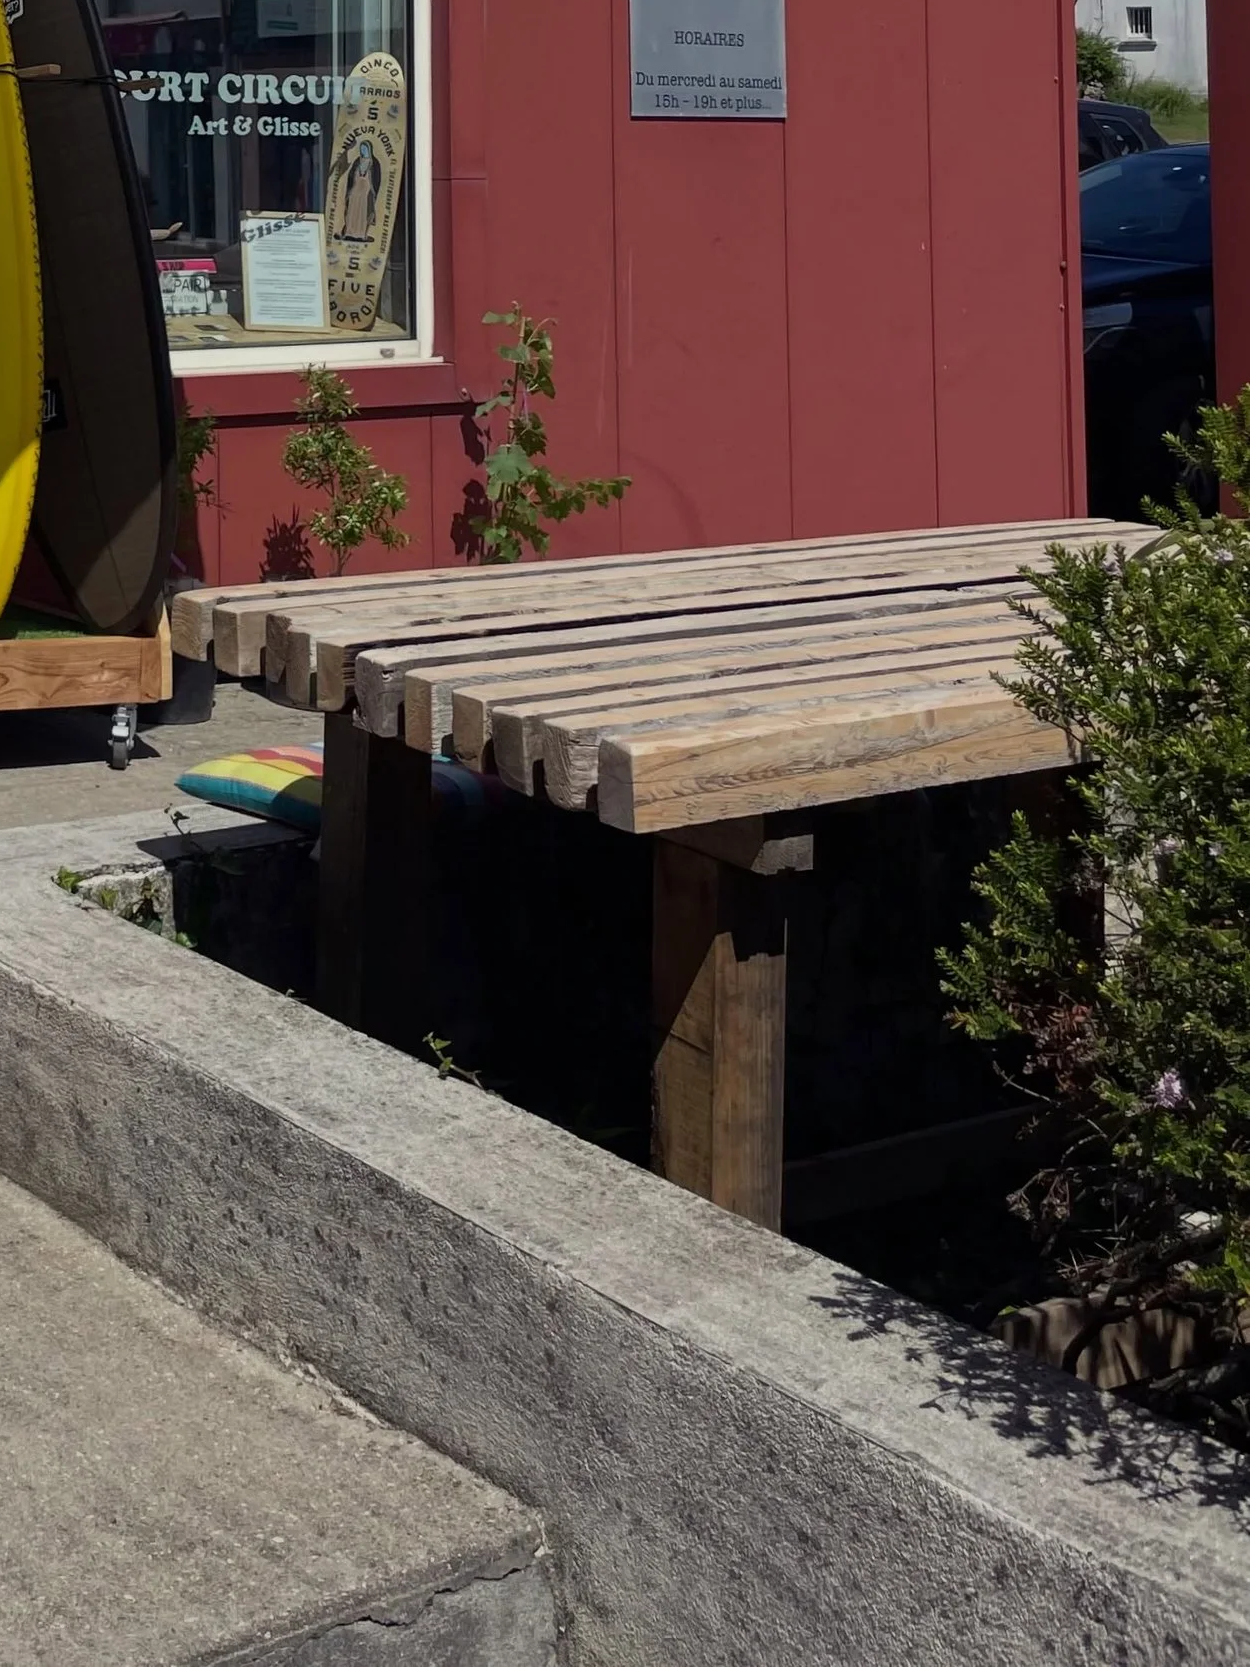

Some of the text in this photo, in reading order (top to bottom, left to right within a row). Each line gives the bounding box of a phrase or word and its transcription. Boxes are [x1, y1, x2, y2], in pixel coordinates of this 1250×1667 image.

[674, 30, 745, 48] HORAIRES
[217, 73, 365, 106] CIRCUIT
[635, 72, 782, 90] Du mercredi au samedi
[693, 95, 717, 109] 19h
[720, 97, 733, 109] et
[187, 115, 321, 137] Art & Glisse
[328, 279, 376, 296] FIVE
